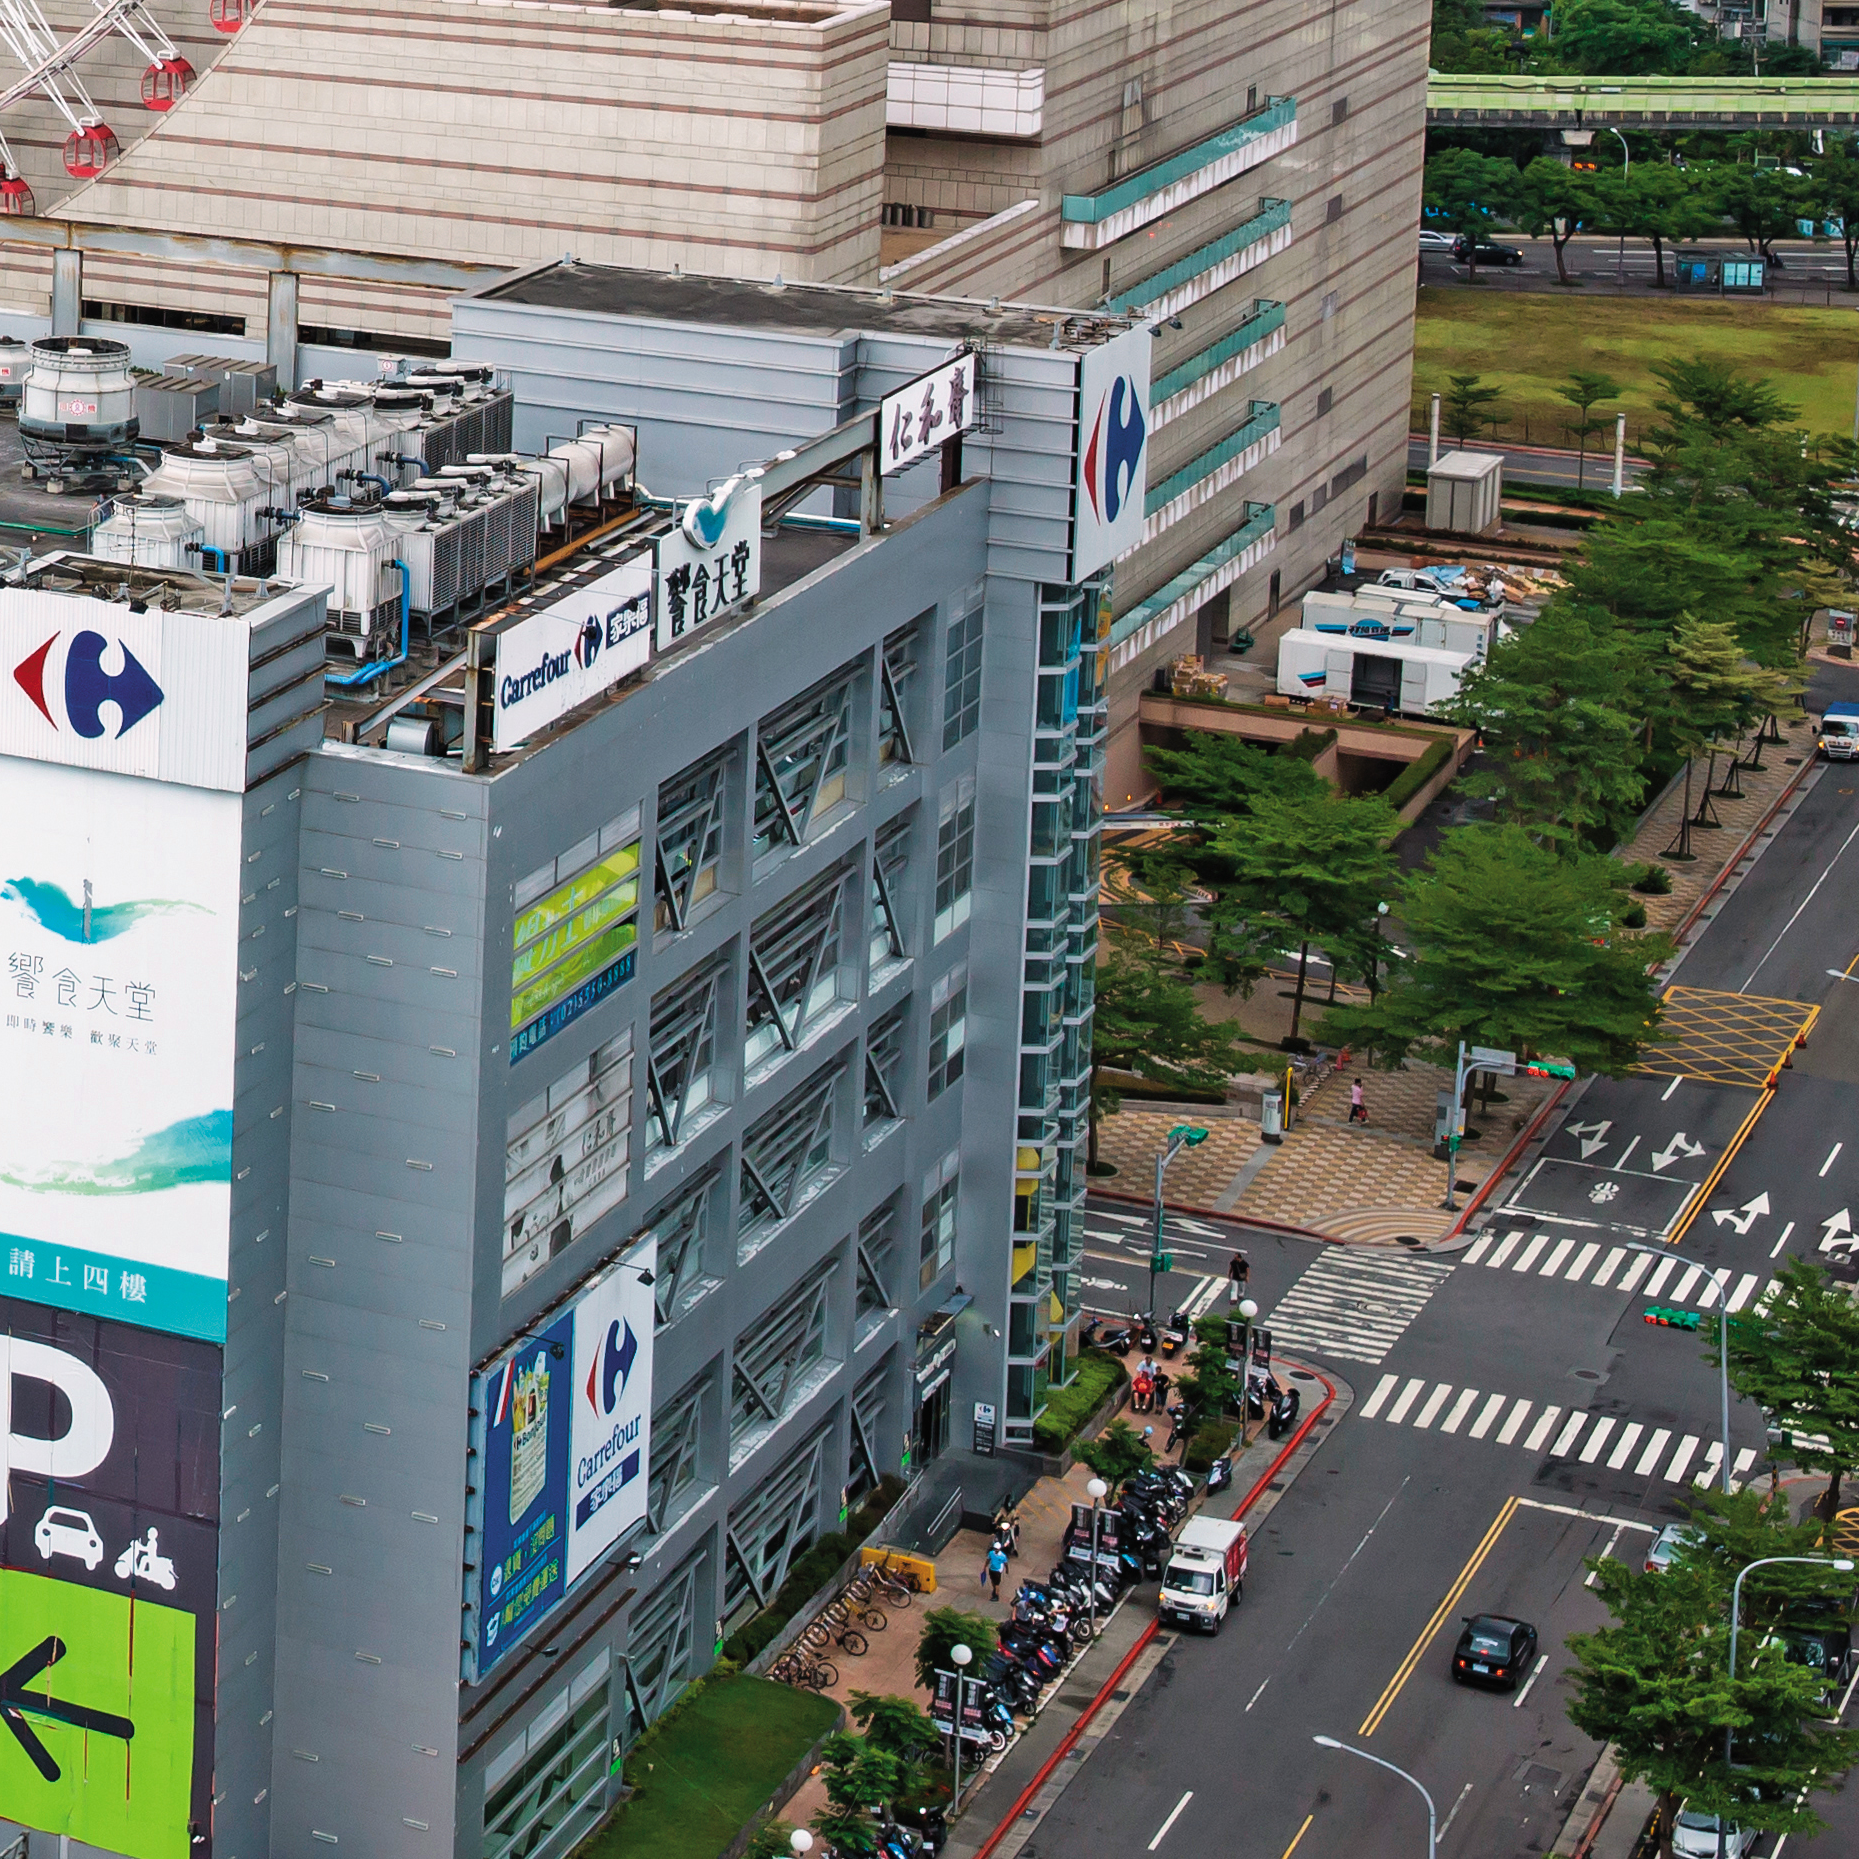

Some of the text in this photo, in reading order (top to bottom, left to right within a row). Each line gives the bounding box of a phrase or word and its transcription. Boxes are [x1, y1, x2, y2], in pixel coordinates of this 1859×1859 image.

[665, 539, 750, 638] 饗食天堂
[501, 648, 572, 709] Carrefour
[8, 952, 156, 1022] 饗食天堂
[8, 1247, 147, 1304] 請上四樓
[577, 1413, 642, 1489] Carrefour
